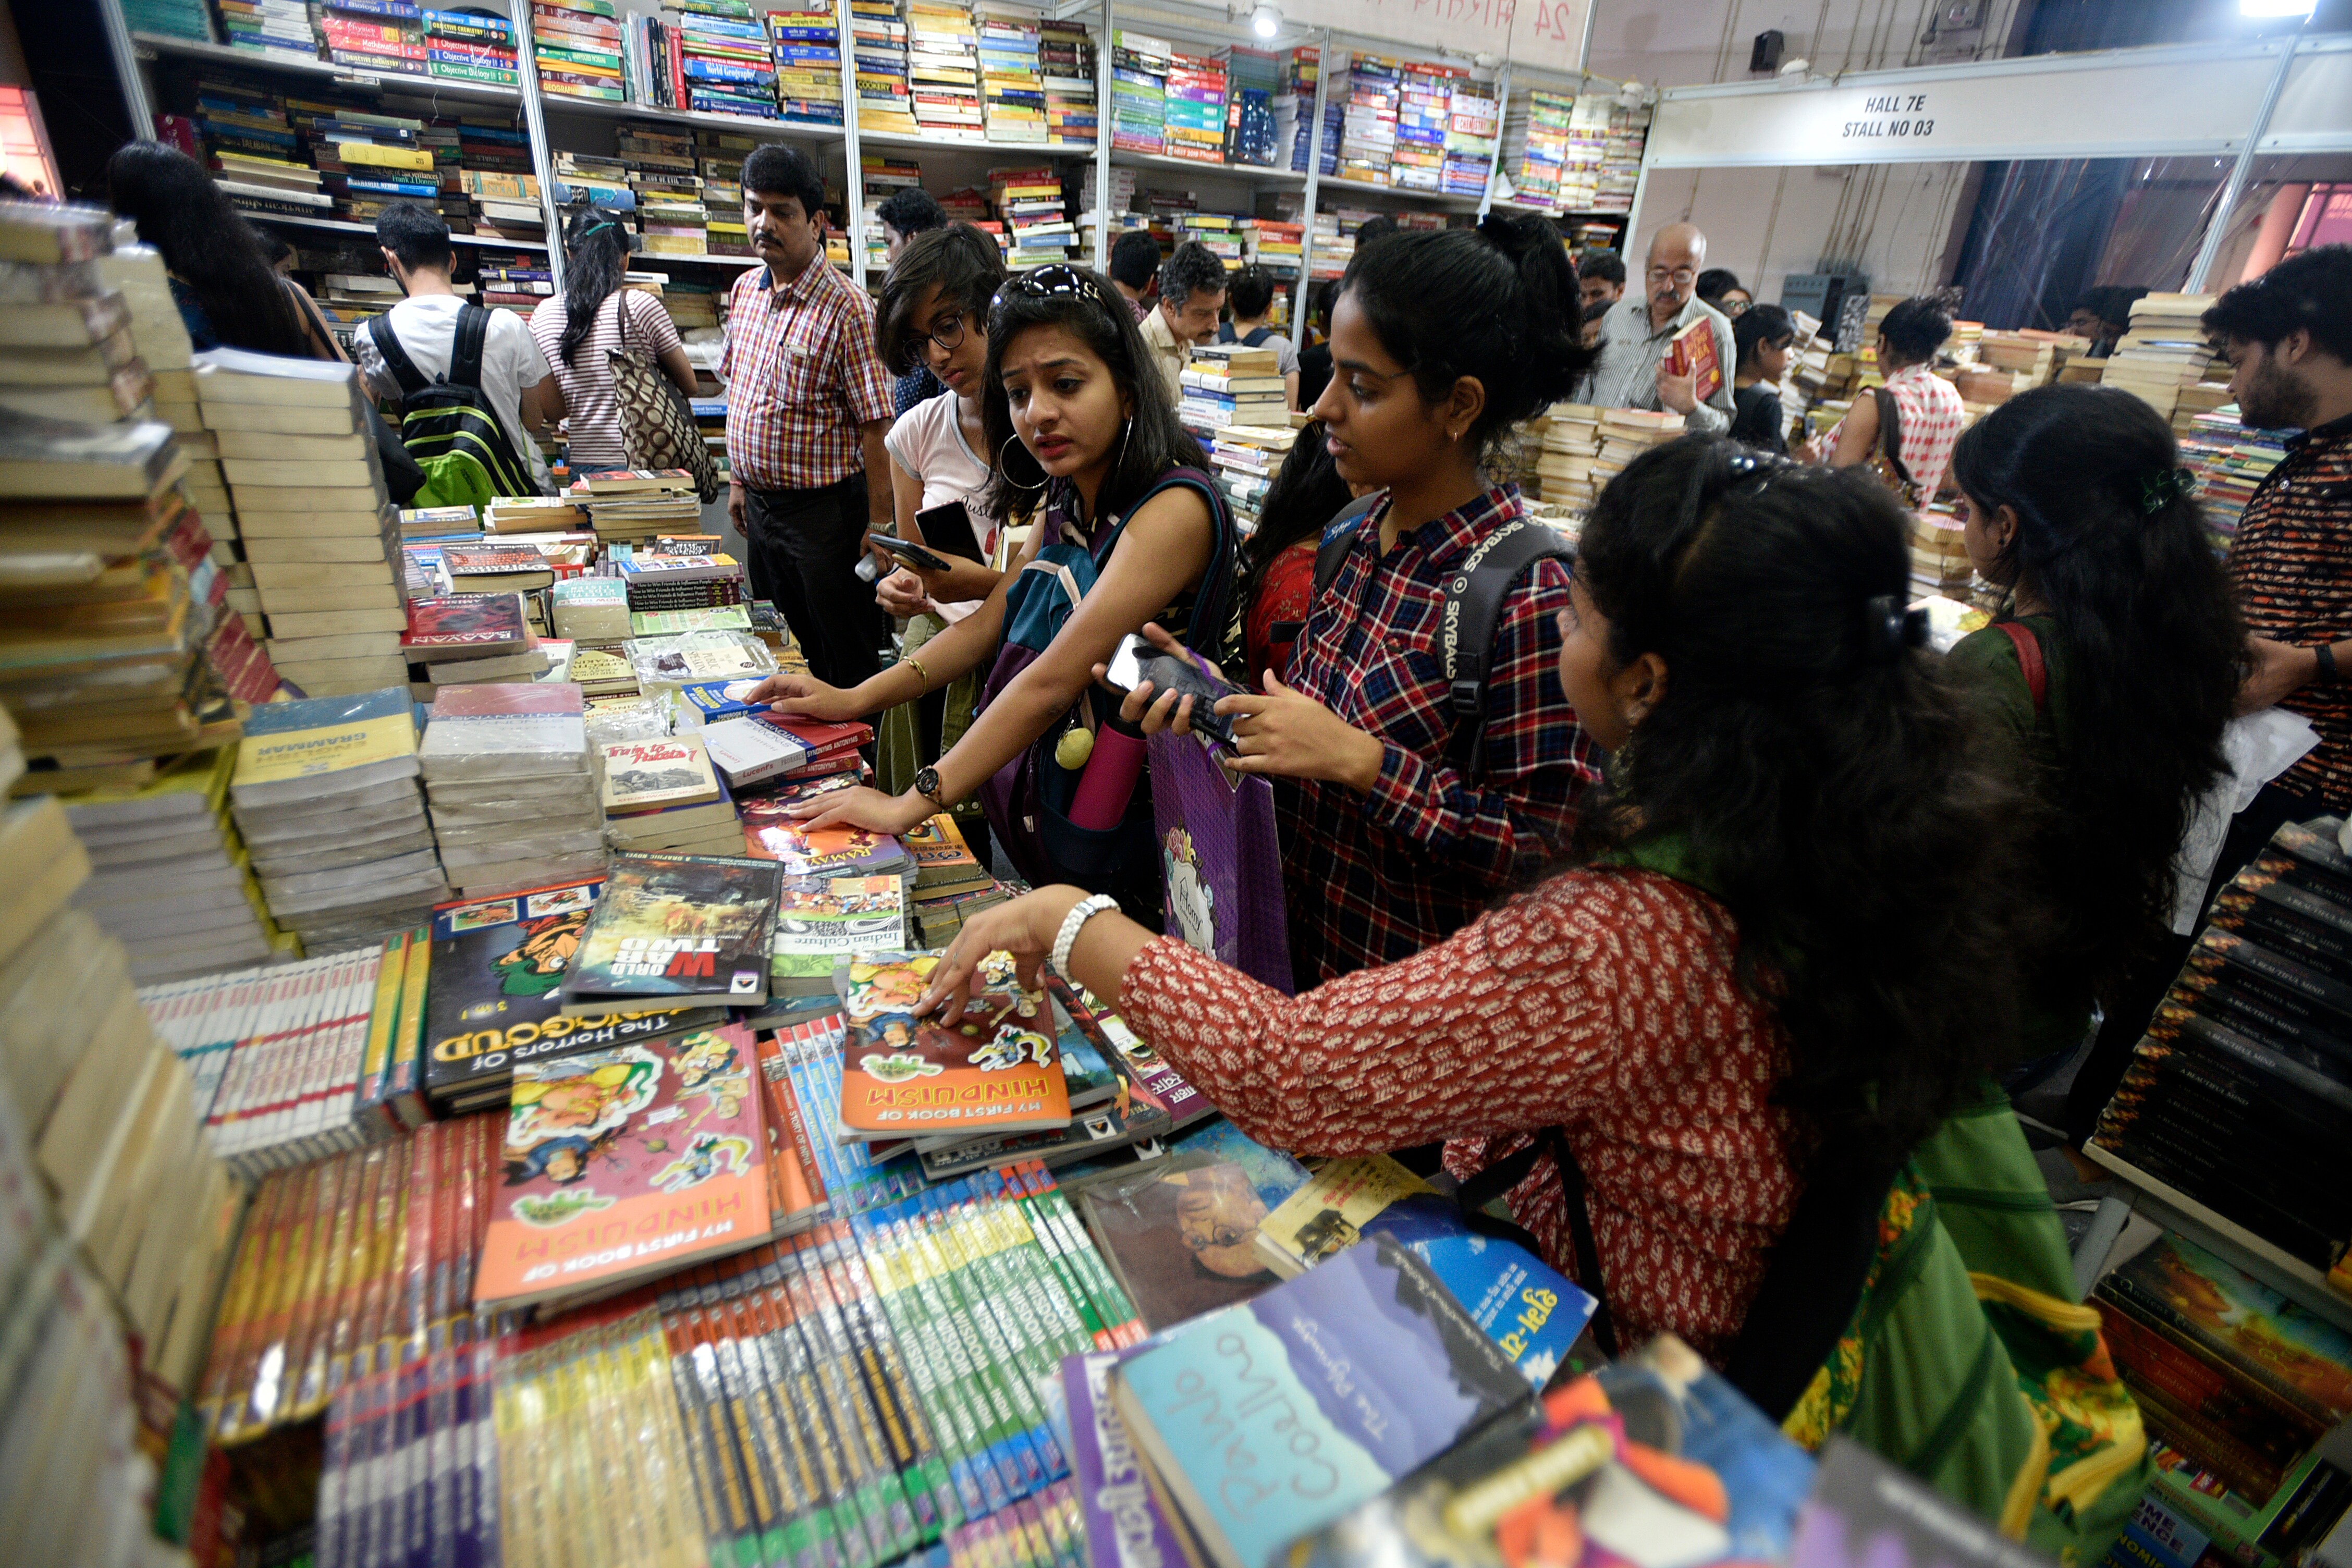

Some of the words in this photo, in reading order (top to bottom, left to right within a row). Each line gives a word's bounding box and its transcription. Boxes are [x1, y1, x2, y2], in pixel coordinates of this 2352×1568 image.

[349, 1, 380, 13] Biology
[432, 22, 460, 32] OBJECTIVE
[462, 26, 484, 35] CHEMISTRY
[362, 40, 399, 52] Mathematics
[441, 40, 468, 51] Objective
[470, 44, 490, 56] Biology
[346, 54, 371, 64] OBJECTIVE
[371, 57, 399, 67] CHEMISTRY
[443, 52, 470, 63] Objective
[472, 56, 492, 67] Biology
[441, 65, 468, 77] Objective
[470, 68, 489, 80] Biology
[706, 63, 722, 75] World
[724, 66, 755, 79] Geography
[544, 83, 578, 94] GEOGRAPHY
[858, 81, 890, 91] COOKERY
[1865, 96, 1900, 113] HALL
[1906, 94, 1927, 112] 7E
[1843, 121, 1882, 137] STALL
[1888, 120, 1910, 137] NO
[1914, 119, 1934, 136] 03
[392, 175, 409, 183] Frank
[646, 174, 658, 182] ICON
[1464, 522, 1524, 572] SKYBAGS
[411, 631, 511, 644] RAAVAN
[1444, 600, 1460, 679] SKYBAGS
[717, 710, 741, 719] HANDBOOK
[754, 717, 804, 743] ANTONYMS
[258, 732, 366, 756] GRAMMAR
[605, 742, 645, 758] Train
[647, 742, 665, 755] to
[742, 763, 774, 778] Lucent's
[805, 743, 833, 758] SYNONYMS
[833, 734, 859, 750] ANTONYMS
[807, 762, 837, 774] ANTONYMS
[617, 790, 675, 803] KHUSHWANT
[617, 938, 721, 952] TWO
[794, 935, 842, 949] Culture
[854, 931, 899, 946] Indian
[496, 1000, 508, 1012] 3
[619, 1015, 669, 1034] The
[513, 1027, 615, 1059] Horrors
[2212, 1033, 2252, 1056] BEAUTIFUL
[2253, 1053, 2276, 1068] MIND
[471, 1051, 509, 1071] Of
[866, 1077, 1049, 1108] HINDUISM
[2186, 1071, 2226, 1093] BEAUTIFUL
[2227, 1090, 2249, 1106] MIND
[877, 1109, 907, 1122] OF
[911, 1106, 962, 1120] BOOK
[971, 1103, 1018, 1117] FIRST
[1020, 1101, 1042, 1112] MY
[788, 1110, 802, 1135] STORY
[795, 1133, 805, 1146] OF
[799, 1145, 812, 1168] INDIA
[512, 1191, 744, 1265] HINDUISM
[702, 1219, 734, 1240] MY
[632, 1227, 697, 1256] FIRST
[562, 1242, 630, 1273] BOOK
[523, 1263, 560, 1283] OF
[1024, 1278, 1065, 1340] WISDOM
[1042, 1272, 1083, 1334] WISDOM
[1006, 1284, 1048, 1348] WISDOM
[938, 1316, 972, 1377] WISDOM
[954, 1309, 989, 1368] WISDOM
[1293, 1316, 1364, 1405] Pilgrimage
[1358, 1411, 1390, 1442] The
